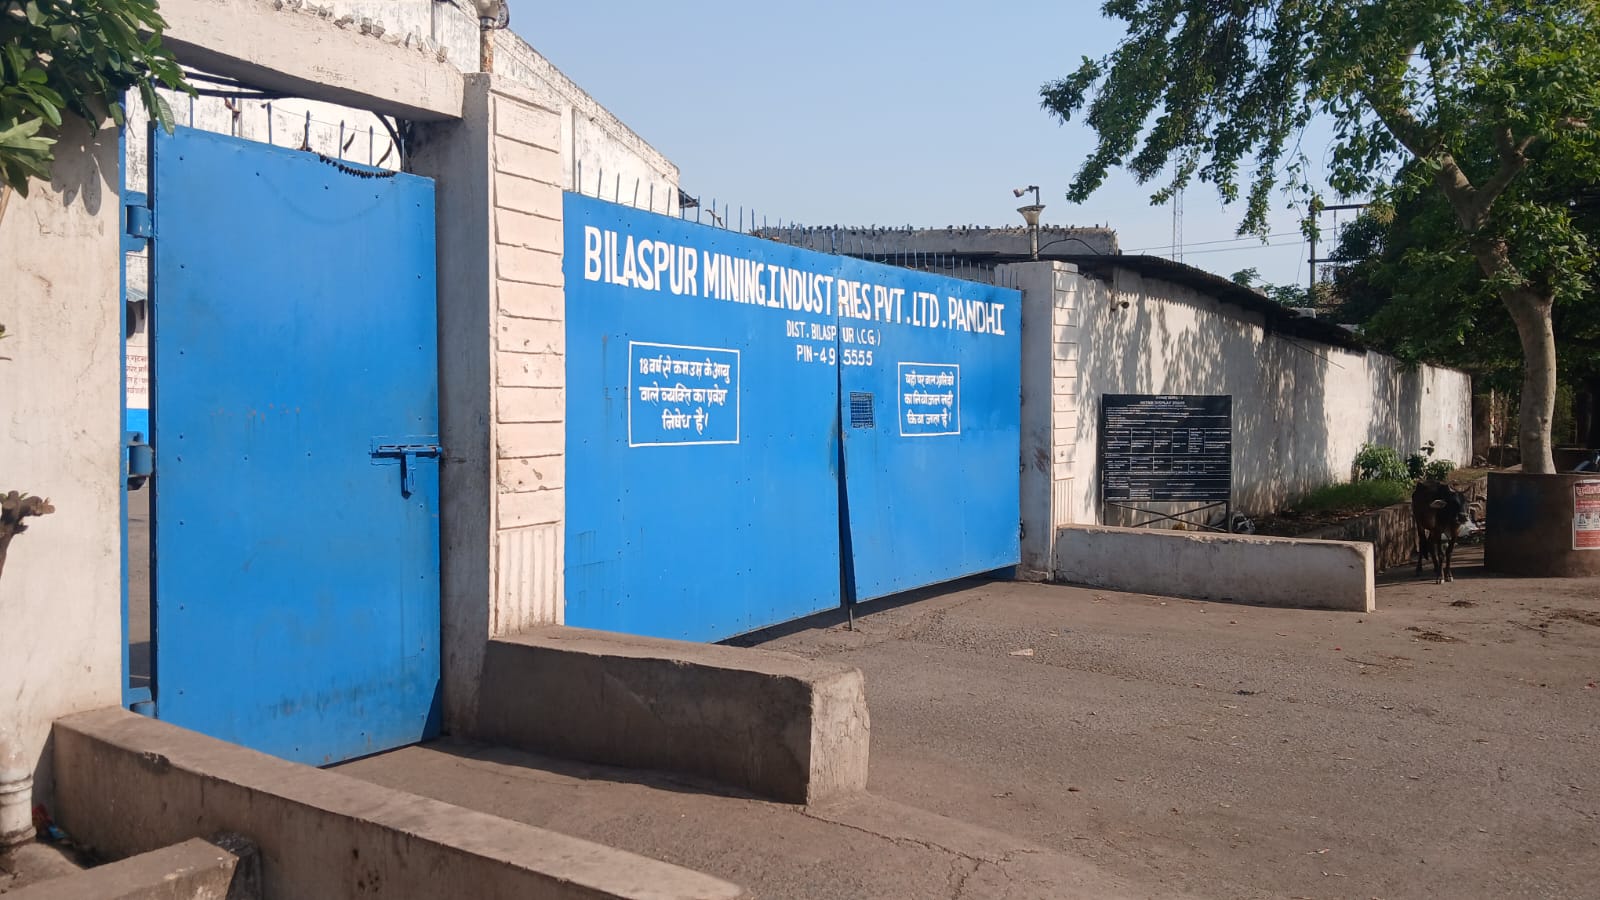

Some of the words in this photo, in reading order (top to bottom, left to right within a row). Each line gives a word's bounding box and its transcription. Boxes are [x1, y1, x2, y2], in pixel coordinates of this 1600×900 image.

[584, 225, 698, 297] BILASPUR
[703, 250, 766, 307] MINING
[948, 296, 1006, 336] PANDHI
[663, 355, 672, 379] से
[703, 357, 713, 376] के
[638, 381, 660, 407] वाले
[692, 388, 706, 403] का
[661, 408, 692, 431] निषेध
